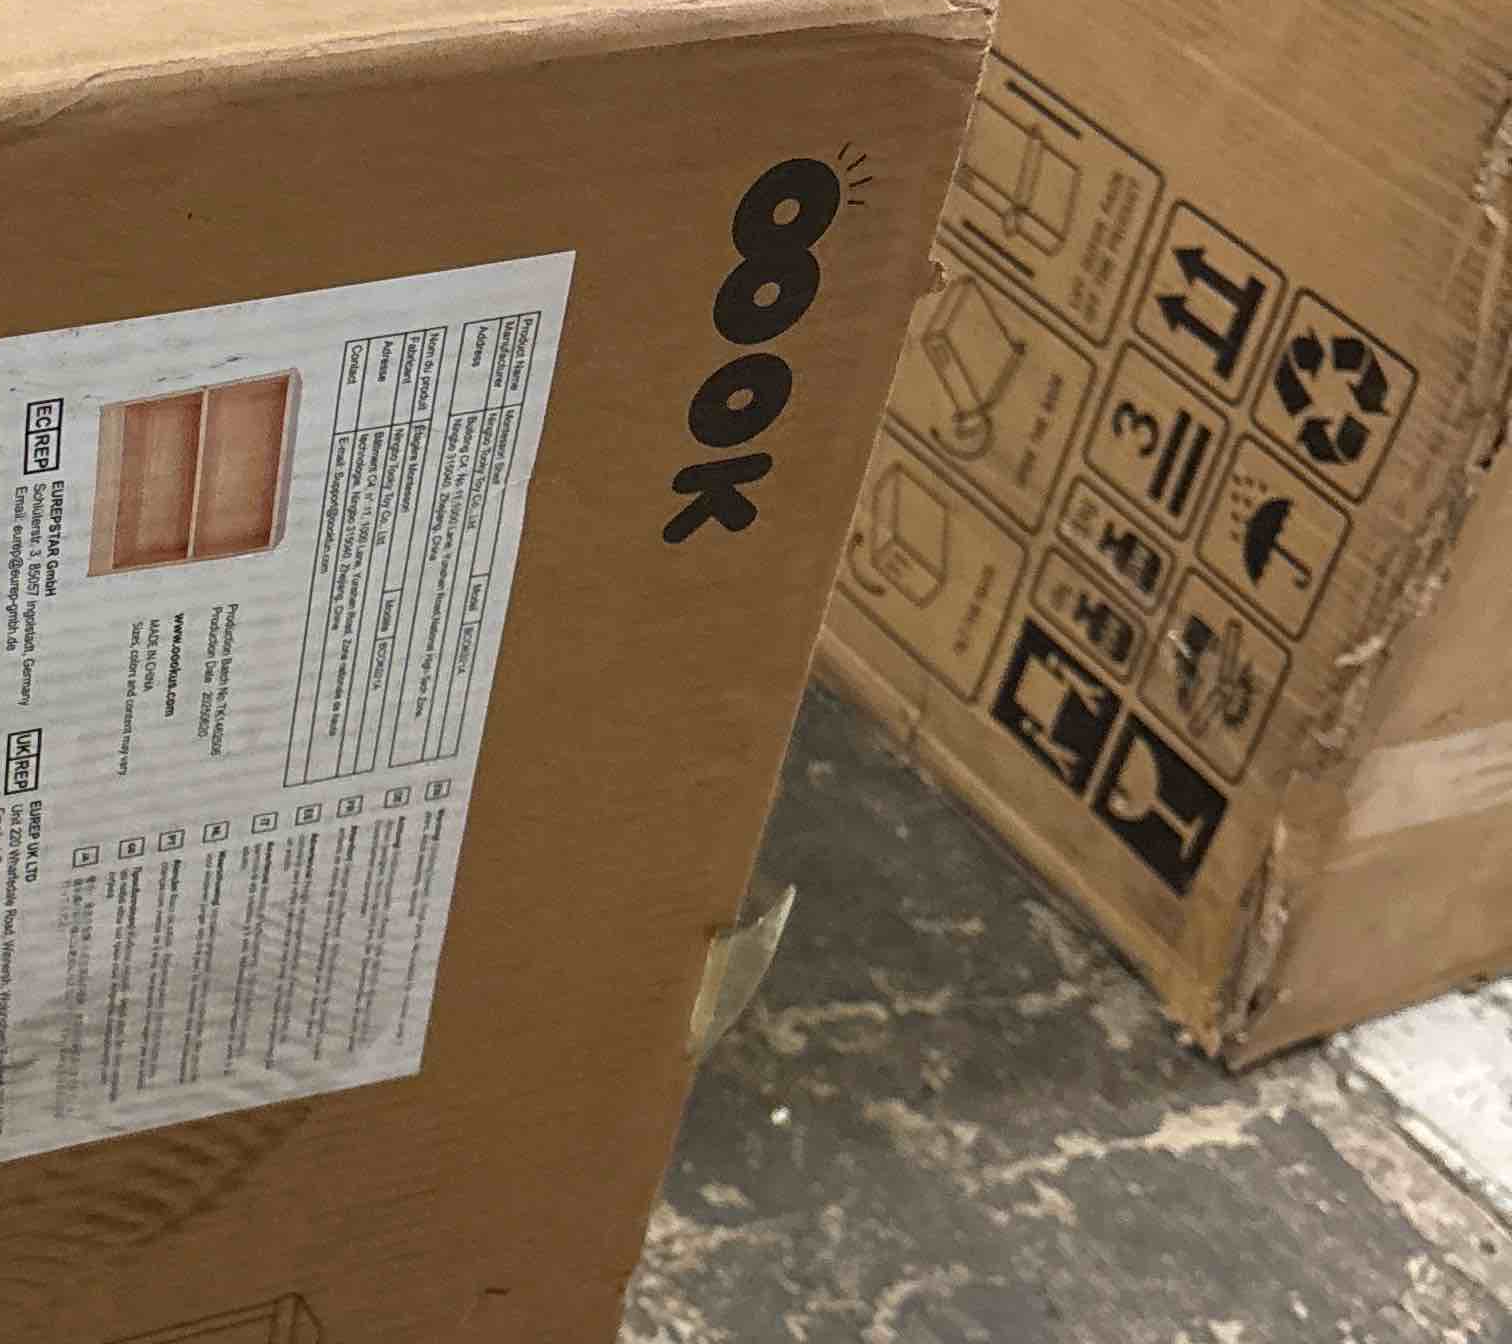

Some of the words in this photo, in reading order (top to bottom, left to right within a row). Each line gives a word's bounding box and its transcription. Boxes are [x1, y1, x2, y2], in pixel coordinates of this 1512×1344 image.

[515, 317, 534, 358] Product
[36, 403, 52, 429] EC
[1109, 400, 1162, 459] 3
[33, 432, 50, 470] REP
[46, 479, 64, 557] EUREPSTAR
[44, 558, 59, 598] GmbH
[146, 618, 160, 647] MADE
[142, 661, 156, 692] CHINA
[164, 612, 186, 717] www.oookus.com
[15, 732, 32, 756] UK
[14, 758, 30, 790] REP
[26, 799, 42, 841] EUREP
[25, 841, 39, 860] UK
[24, 861, 37, 883] LTD
